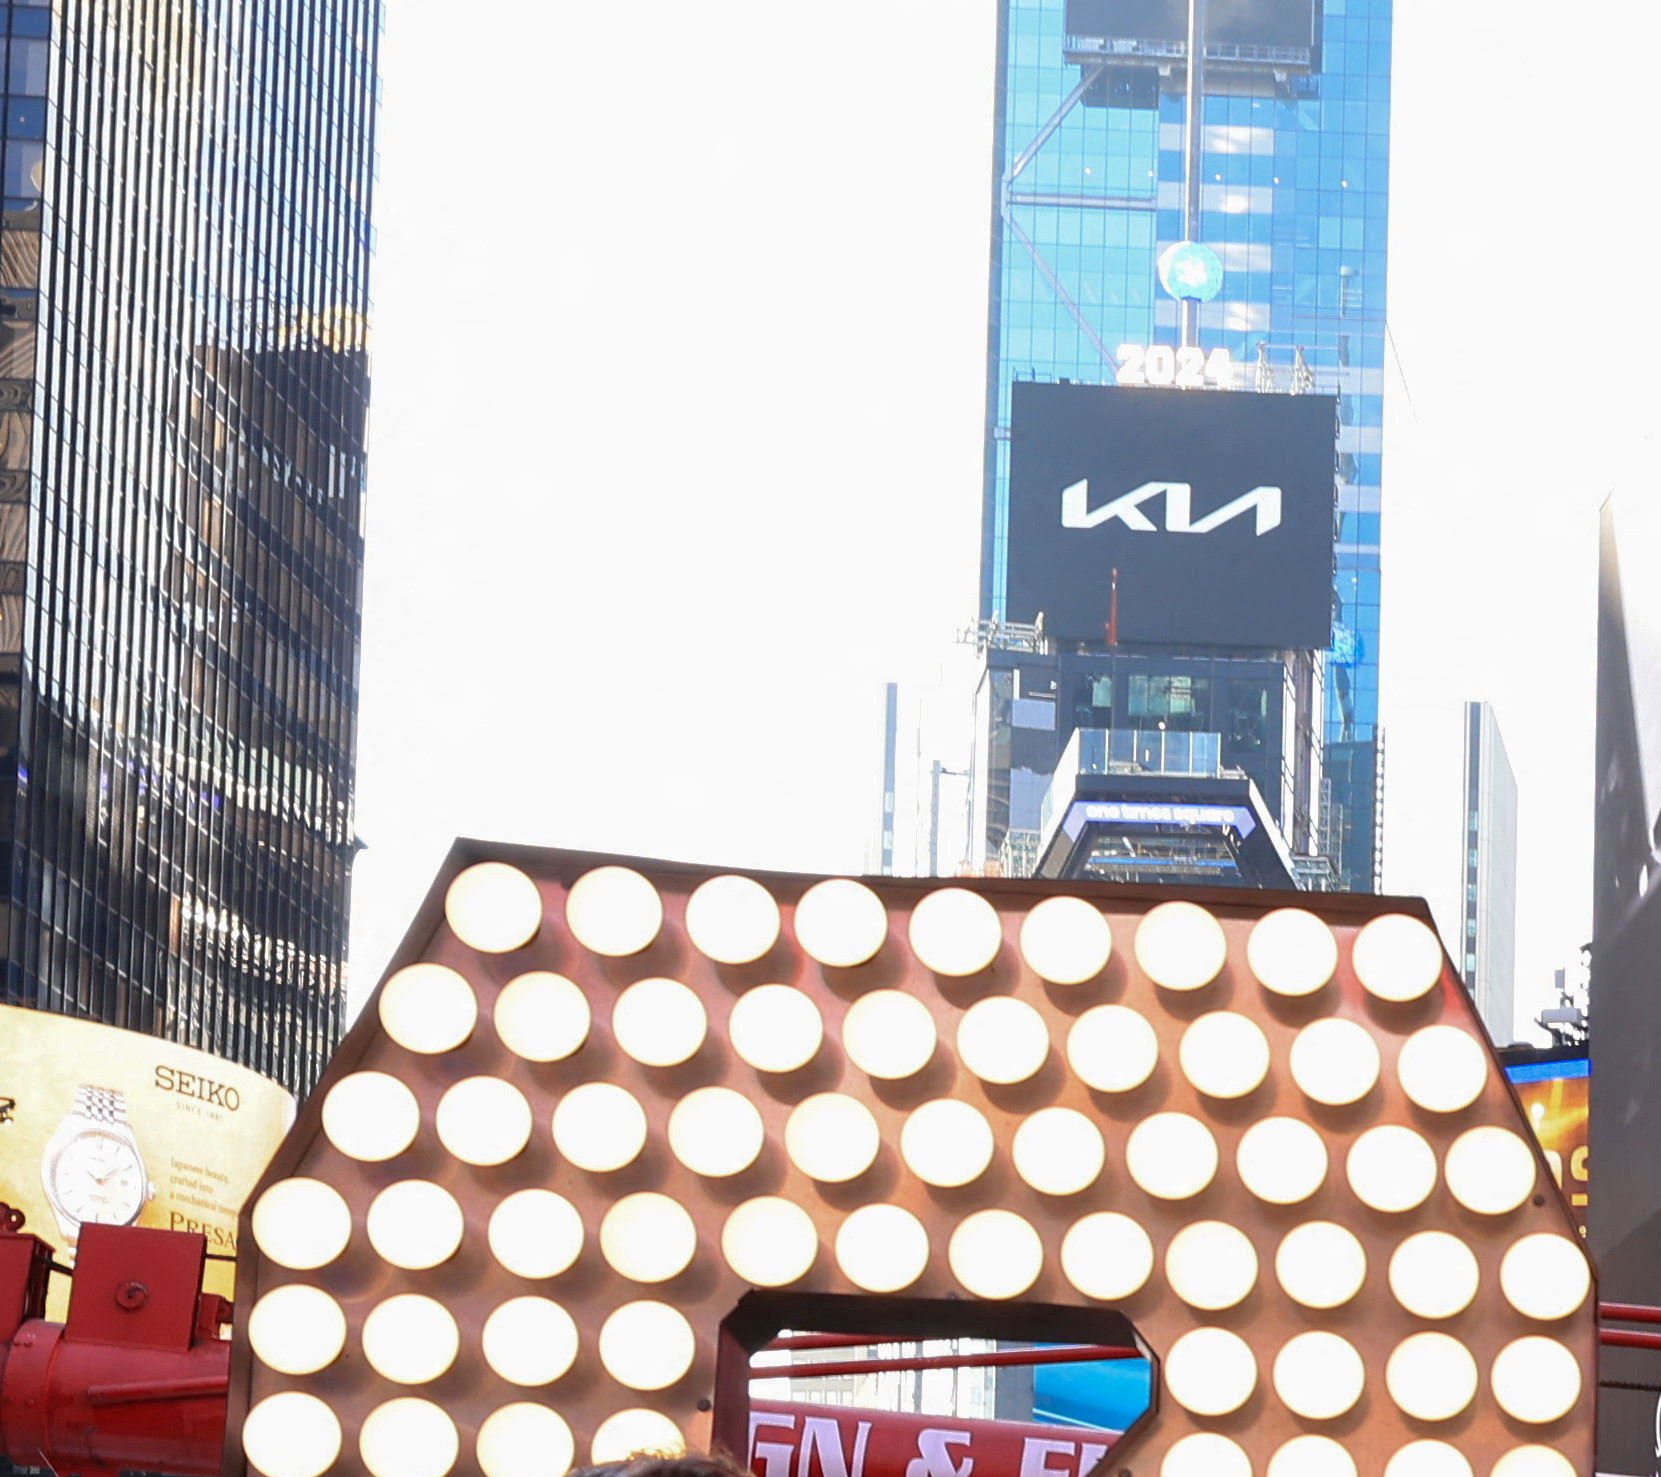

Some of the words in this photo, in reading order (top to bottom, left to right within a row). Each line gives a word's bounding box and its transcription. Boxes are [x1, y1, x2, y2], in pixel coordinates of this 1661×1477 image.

[1116, 343, 1236, 389] 2024
[1061, 478, 1281, 537] KIA
[155, 1065, 240, 1112] SEIKO
